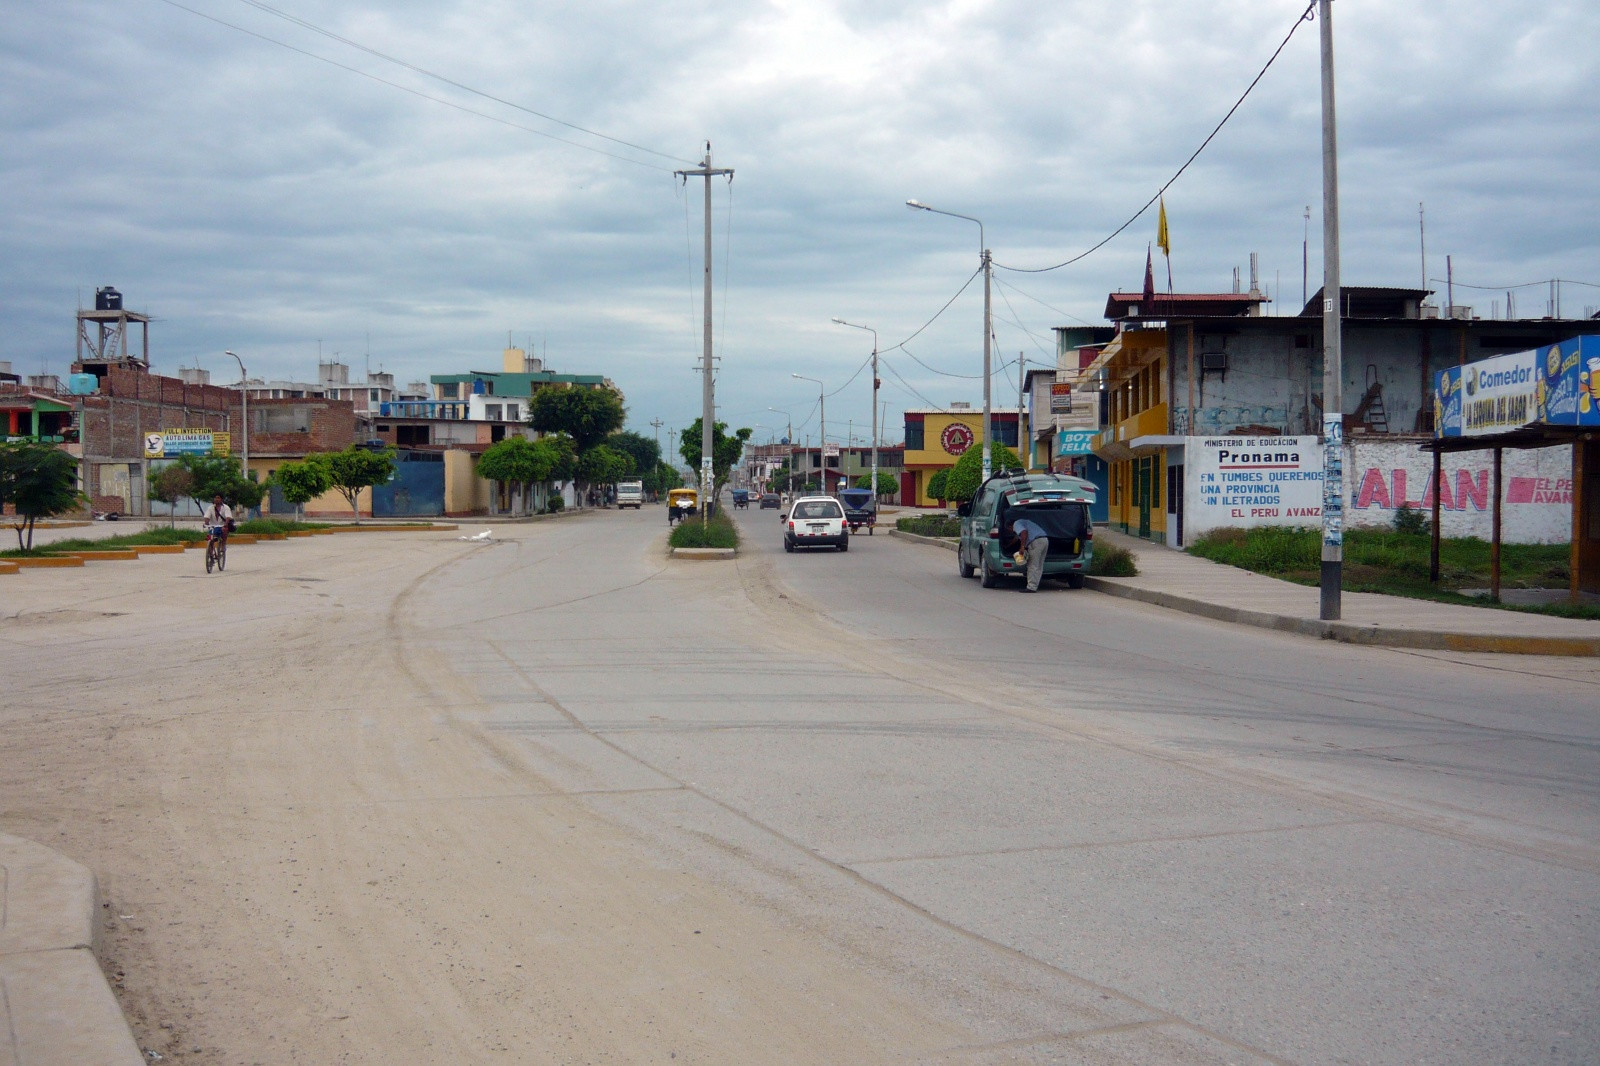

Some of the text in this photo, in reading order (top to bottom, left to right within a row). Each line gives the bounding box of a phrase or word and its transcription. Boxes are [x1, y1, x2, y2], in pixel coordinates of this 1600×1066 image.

[1479, 365, 1532, 390] Comedor
[1219, 450, 1299, 463] Pronama
[1221, 473, 1263, 481] TUMBES
[1269, 472, 1324, 481] QUEREMOS
[1536, 478, 1551, 490] EL
[1201, 485, 1280, 494] UNA PROVINCIA
[1354, 468, 1489, 511] ALAN
[1222, 496, 1280, 505] ILETRADOS
[1231, 509, 1245, 517] EL
[1251, 509, 1279, 517] PERU
